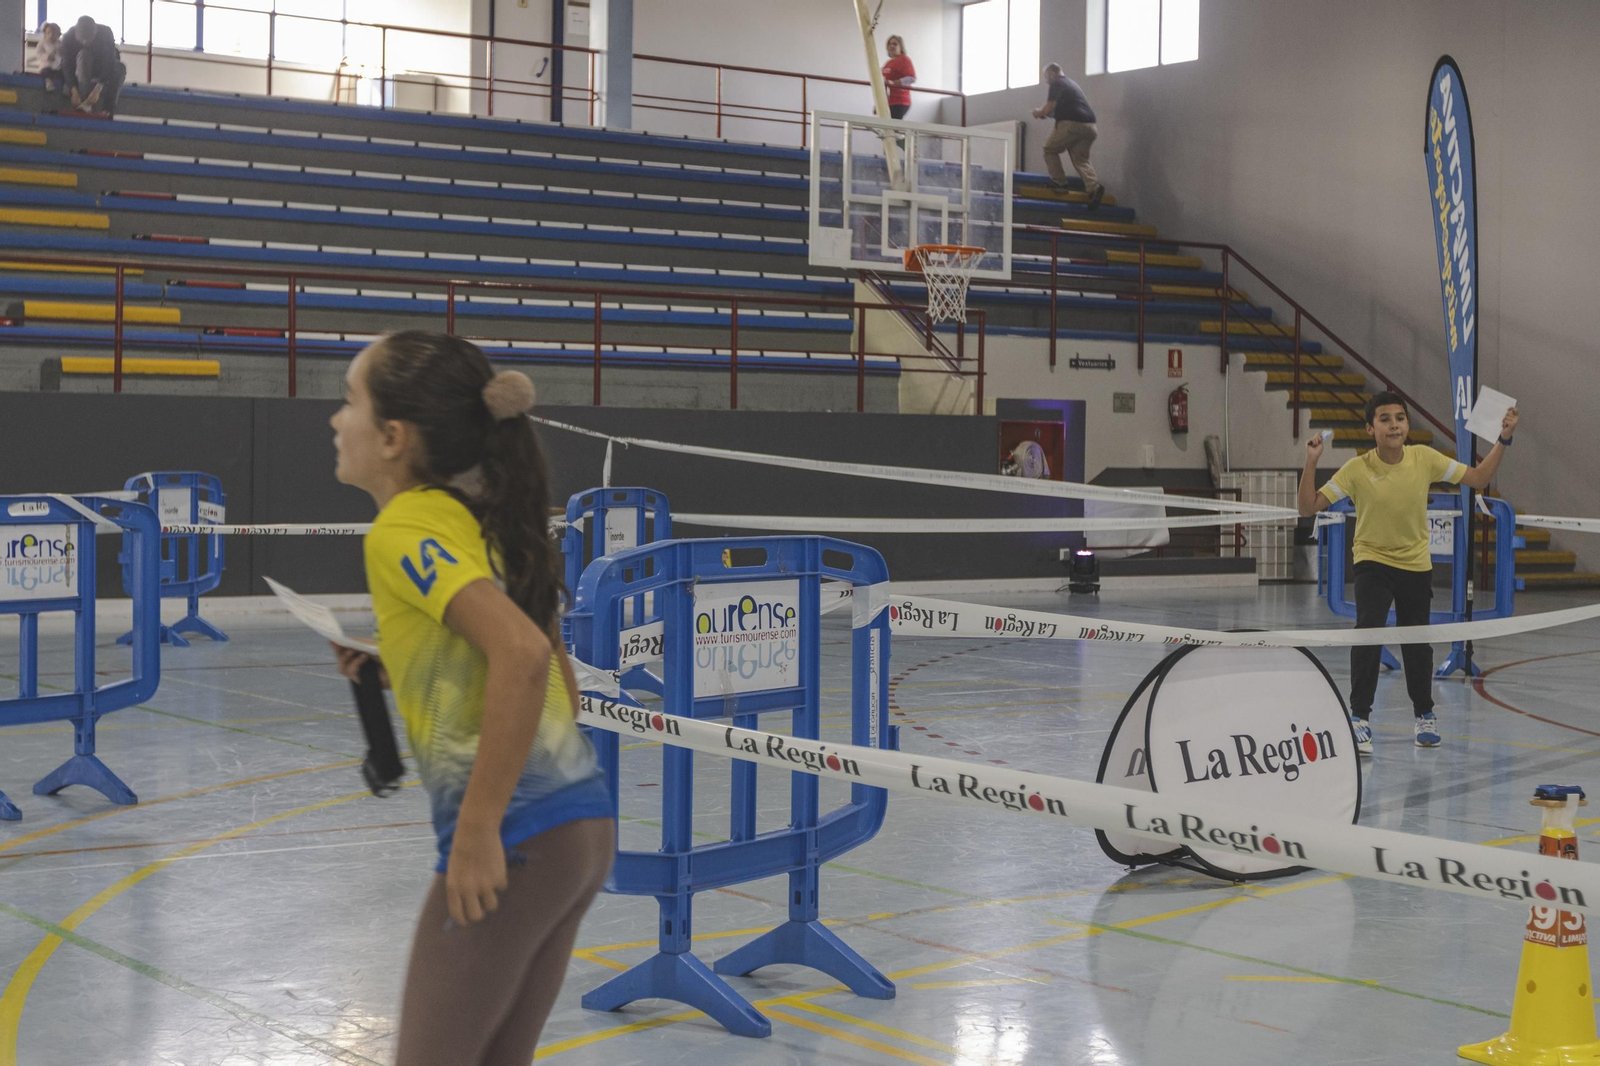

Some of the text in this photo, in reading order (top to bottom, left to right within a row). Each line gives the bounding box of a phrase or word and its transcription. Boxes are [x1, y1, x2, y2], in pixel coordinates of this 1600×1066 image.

[695, 629, 797, 645] www.turismourense.com
[696, 595, 796, 634] ourense
[725, 728, 861, 776] La Región
[1175, 739, 1232, 784] La
[1230, 722, 1338, 782] Región
[910, 764, 1068, 817] La Región
[1124, 804, 1308, 861] La Región
[1372, 846, 1588, 907] La Región
